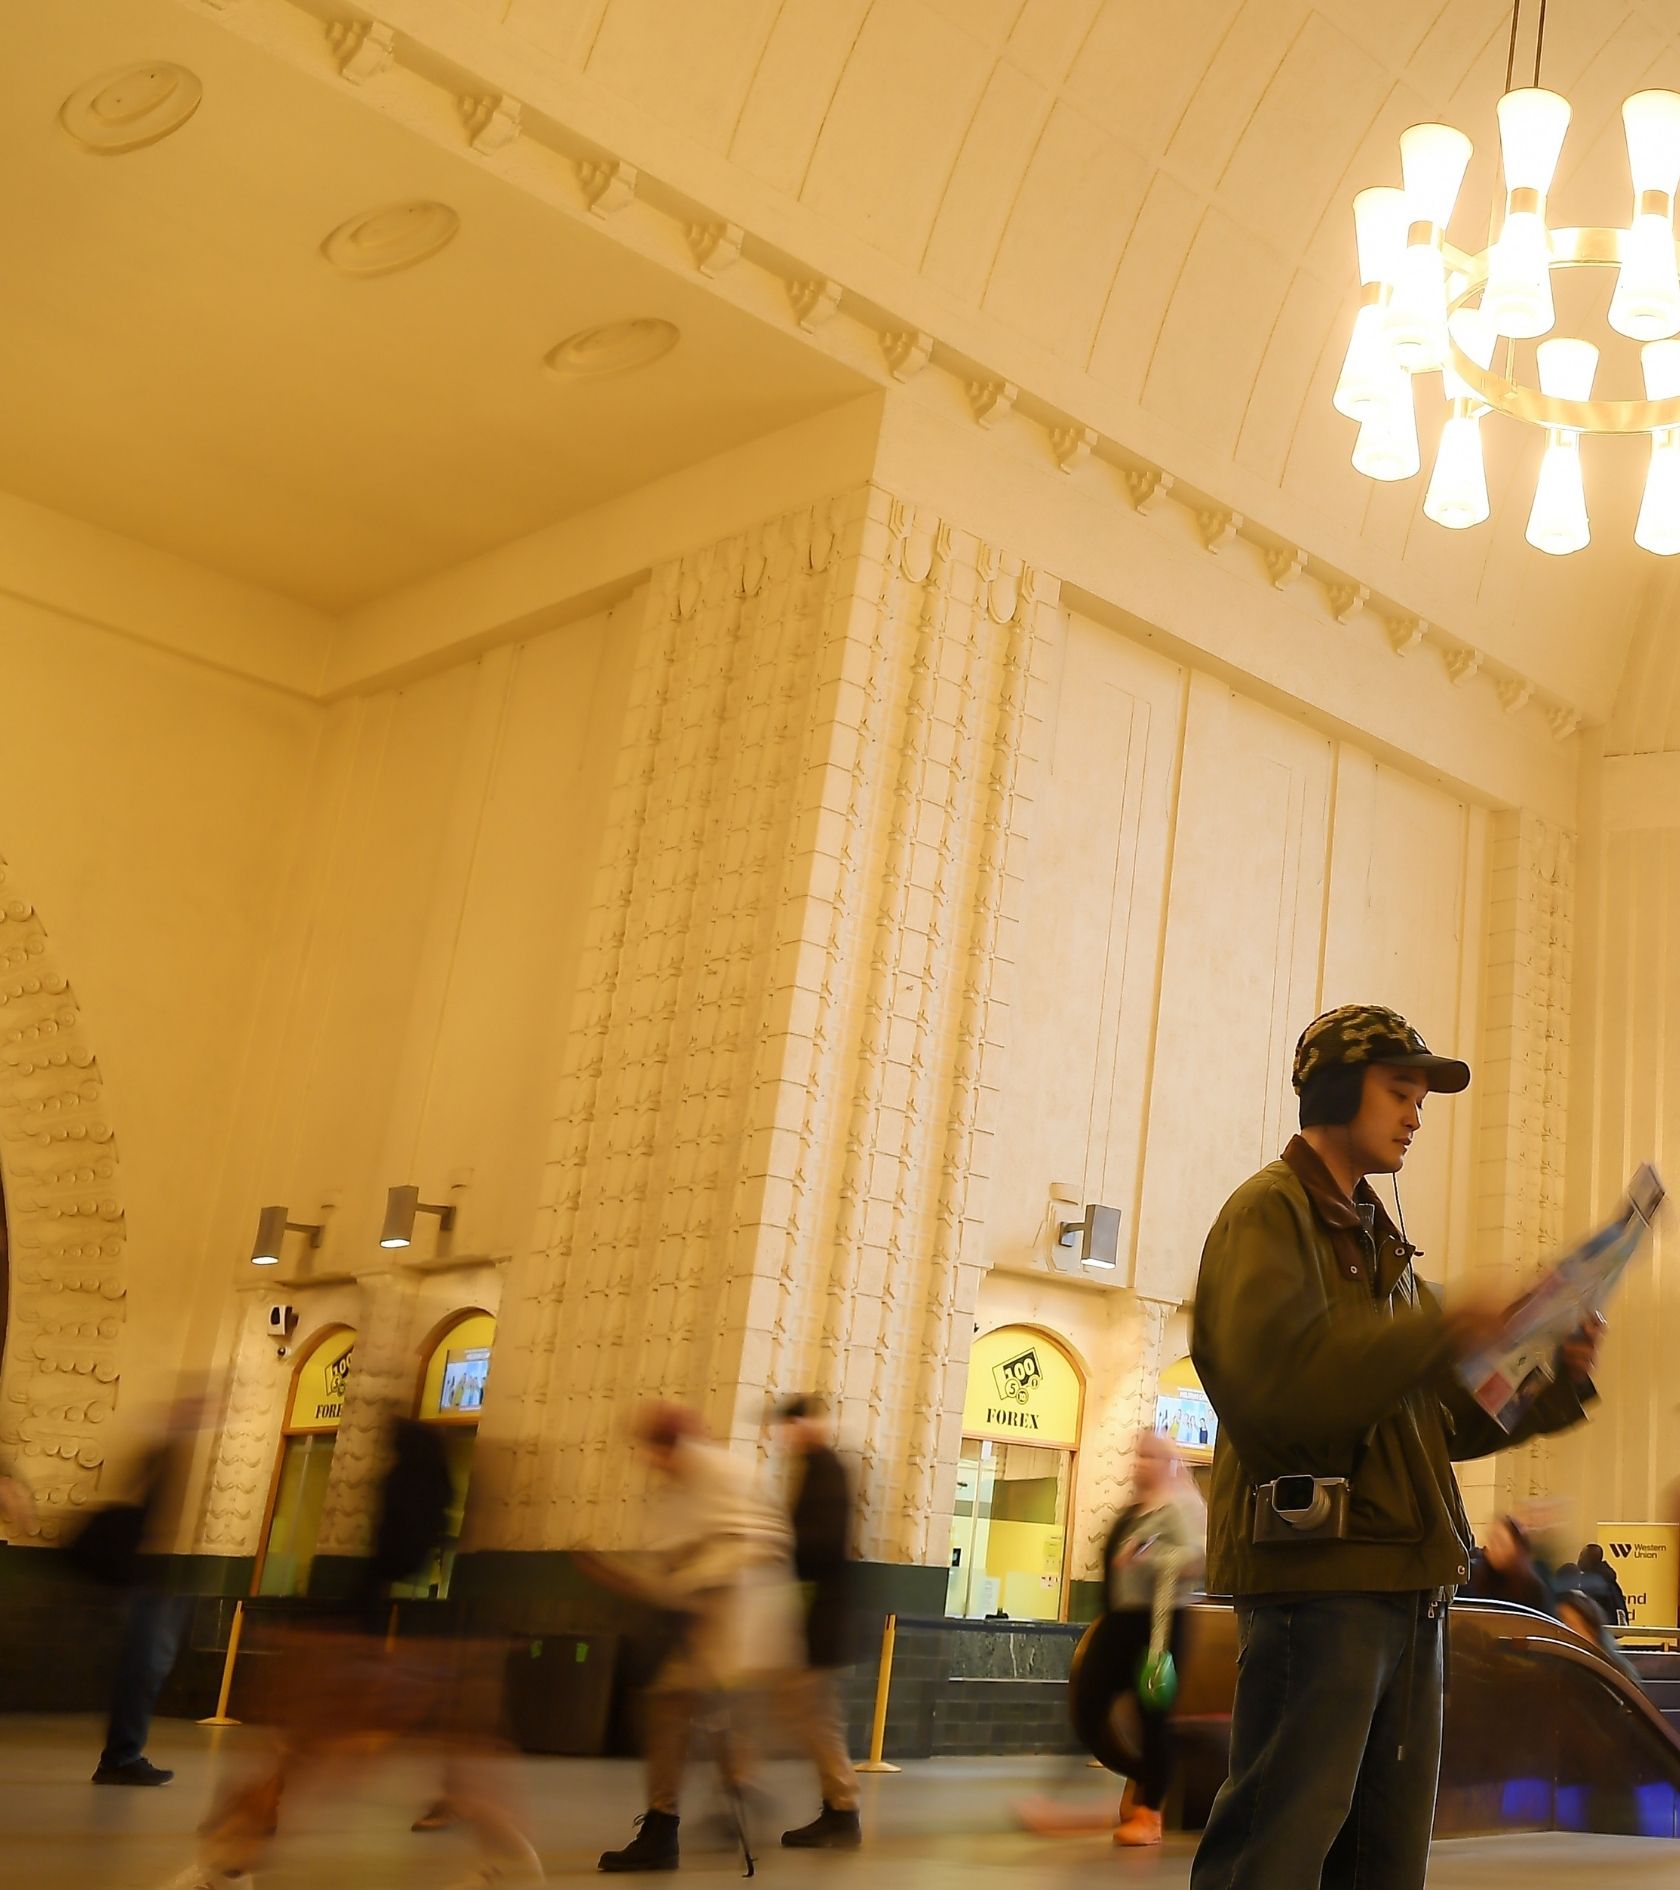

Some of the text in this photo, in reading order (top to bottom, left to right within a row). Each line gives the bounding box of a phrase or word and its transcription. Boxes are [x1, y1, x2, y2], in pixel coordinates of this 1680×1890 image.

[1004, 1358, 1035, 1381] 100
[316, 1404, 342, 1419] FORE
[986, 1408, 1040, 1429] FOREX
